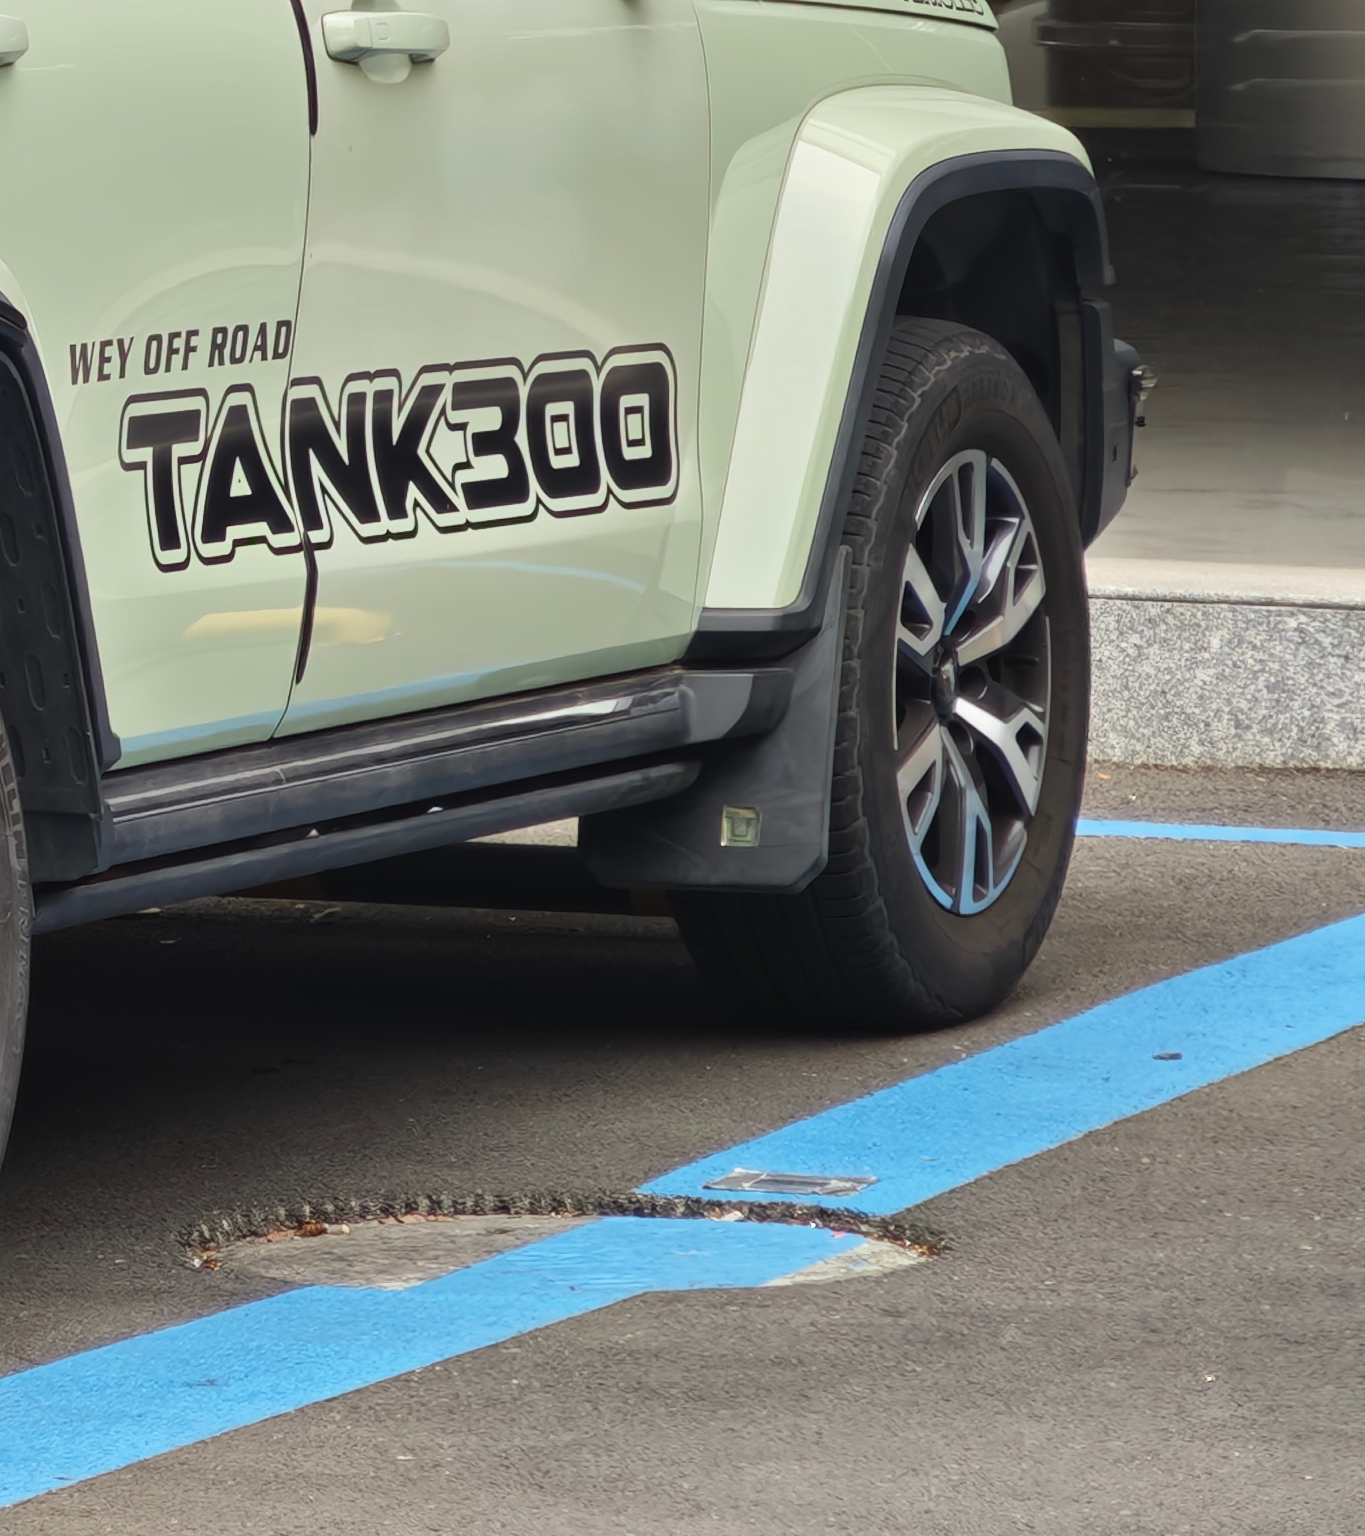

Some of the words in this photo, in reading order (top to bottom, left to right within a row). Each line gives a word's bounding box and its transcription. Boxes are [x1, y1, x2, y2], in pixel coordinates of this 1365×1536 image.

[68, 335, 136, 387] WEY
[143, 327, 199, 376] OFF
[209, 318, 294, 366] ROAD
[119, 342, 680, 574] TANK300
